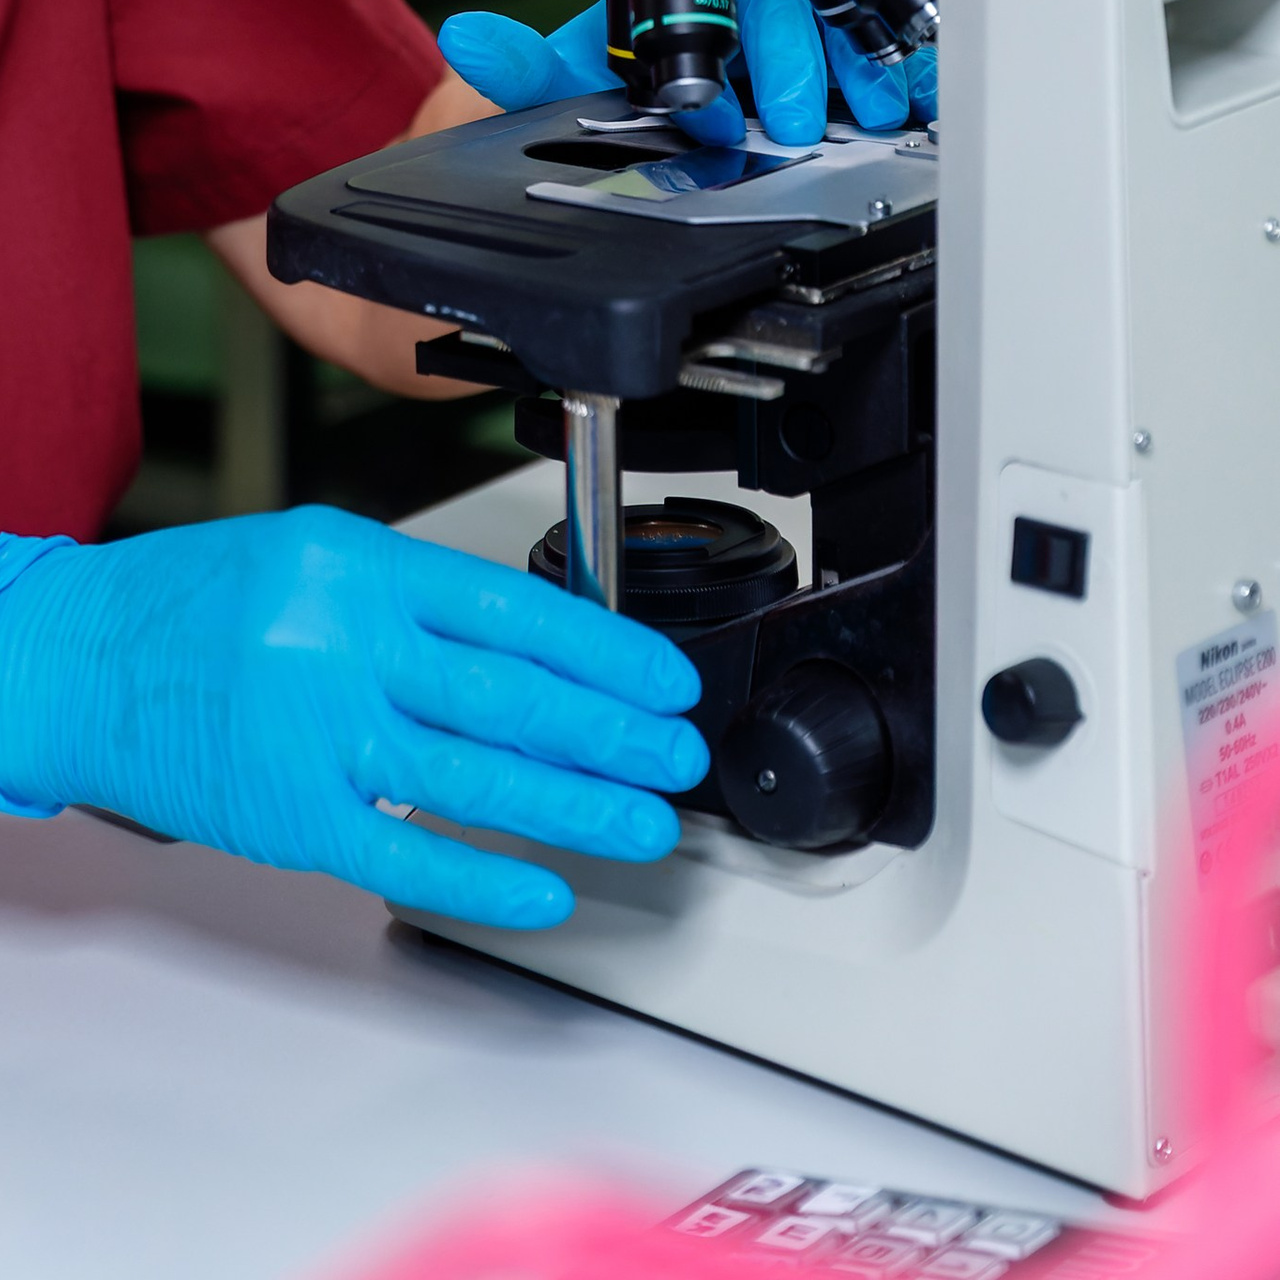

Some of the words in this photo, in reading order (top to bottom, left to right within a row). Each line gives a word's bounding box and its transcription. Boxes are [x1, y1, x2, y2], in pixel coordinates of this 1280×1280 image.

[1200, 640, 1239, 672] Nikon
[1184, 677, 1219, 708] MODEL
[1218, 655, 1256, 692] ECLIPSE
